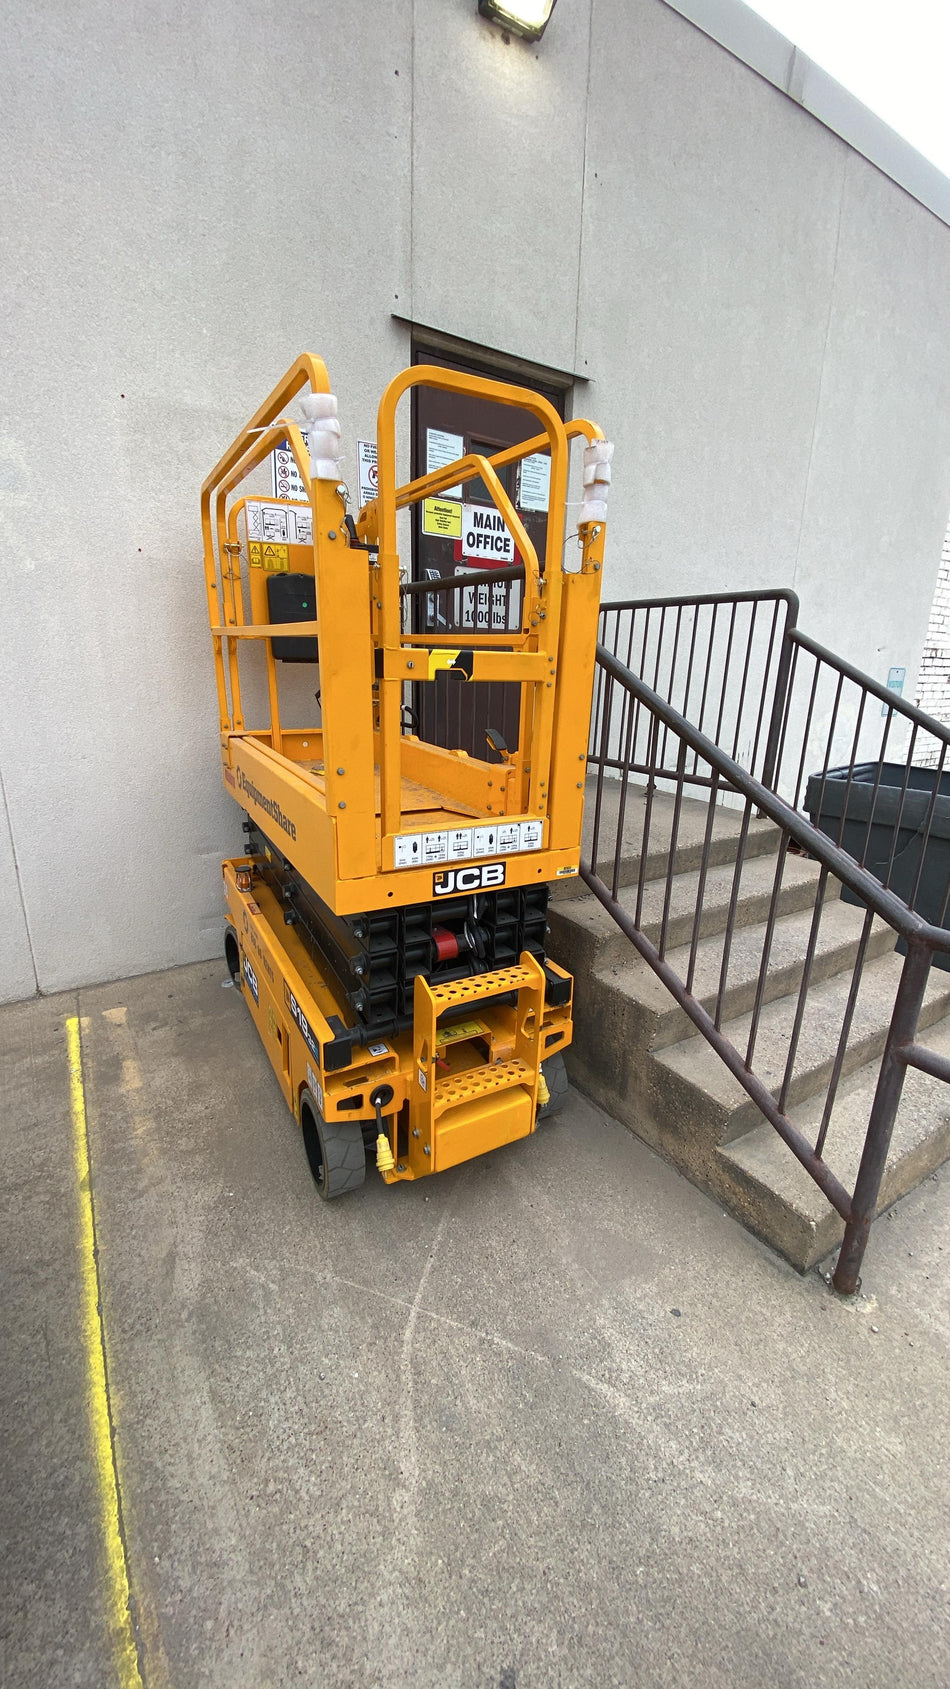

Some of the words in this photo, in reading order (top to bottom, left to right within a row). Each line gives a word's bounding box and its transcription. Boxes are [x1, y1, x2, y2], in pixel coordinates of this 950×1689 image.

[473, 512, 505, 532] MAIN
[466, 532, 510, 553] OFFICE
[435, 864, 504, 894] JCB
